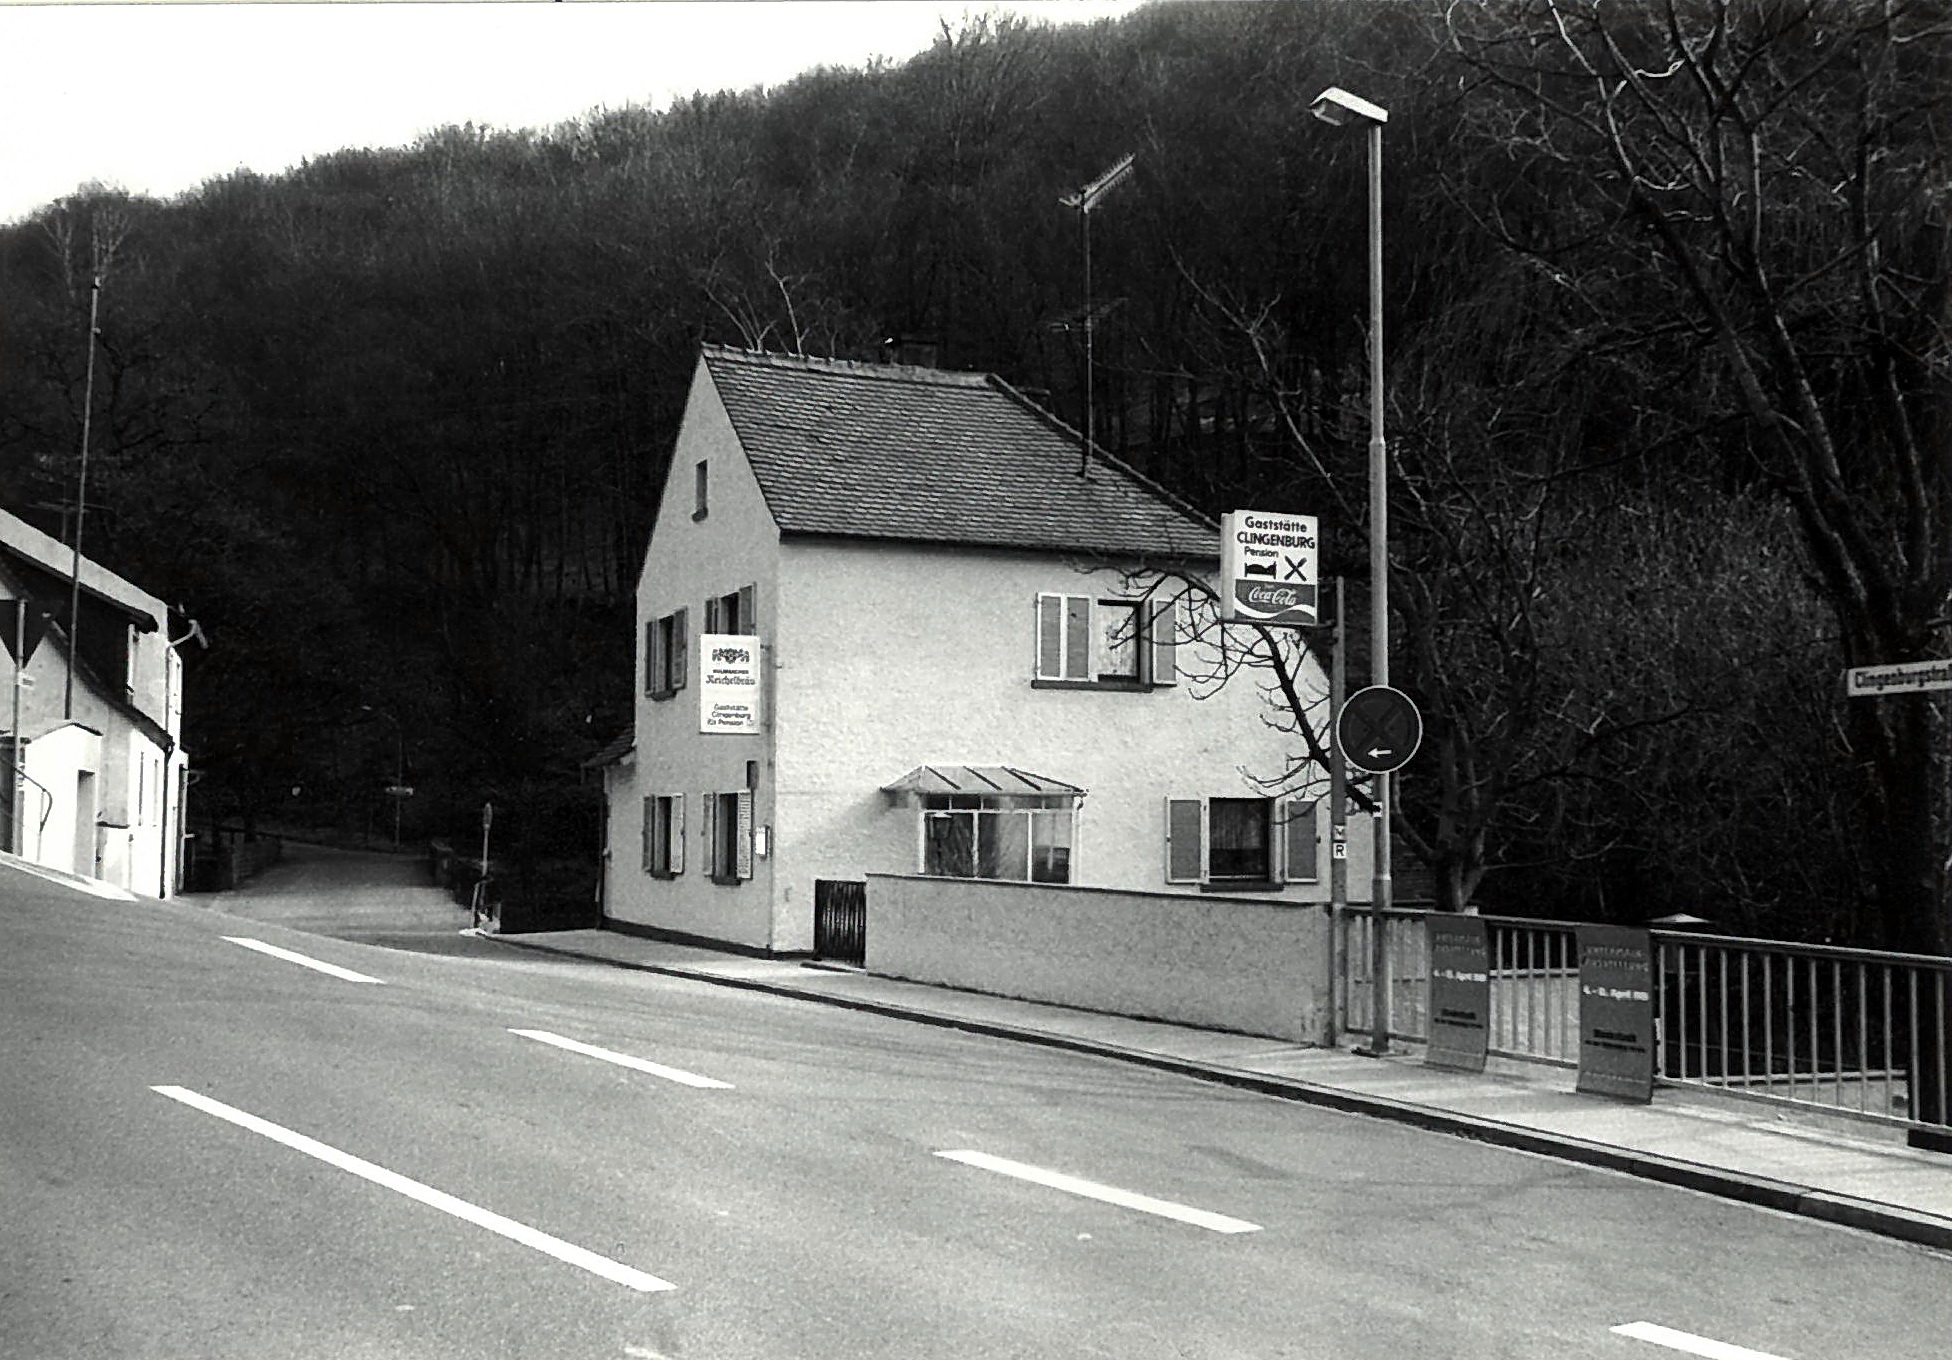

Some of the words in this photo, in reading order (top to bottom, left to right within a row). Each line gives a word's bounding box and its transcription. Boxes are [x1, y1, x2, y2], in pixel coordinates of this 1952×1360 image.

[1244, 516, 1307, 532] Gaststätte
[1237, 531, 1315, 549] CLINGENBURG
[1244, 546, 1279, 558] Pension
[1335, 844, 1345, 857] R
